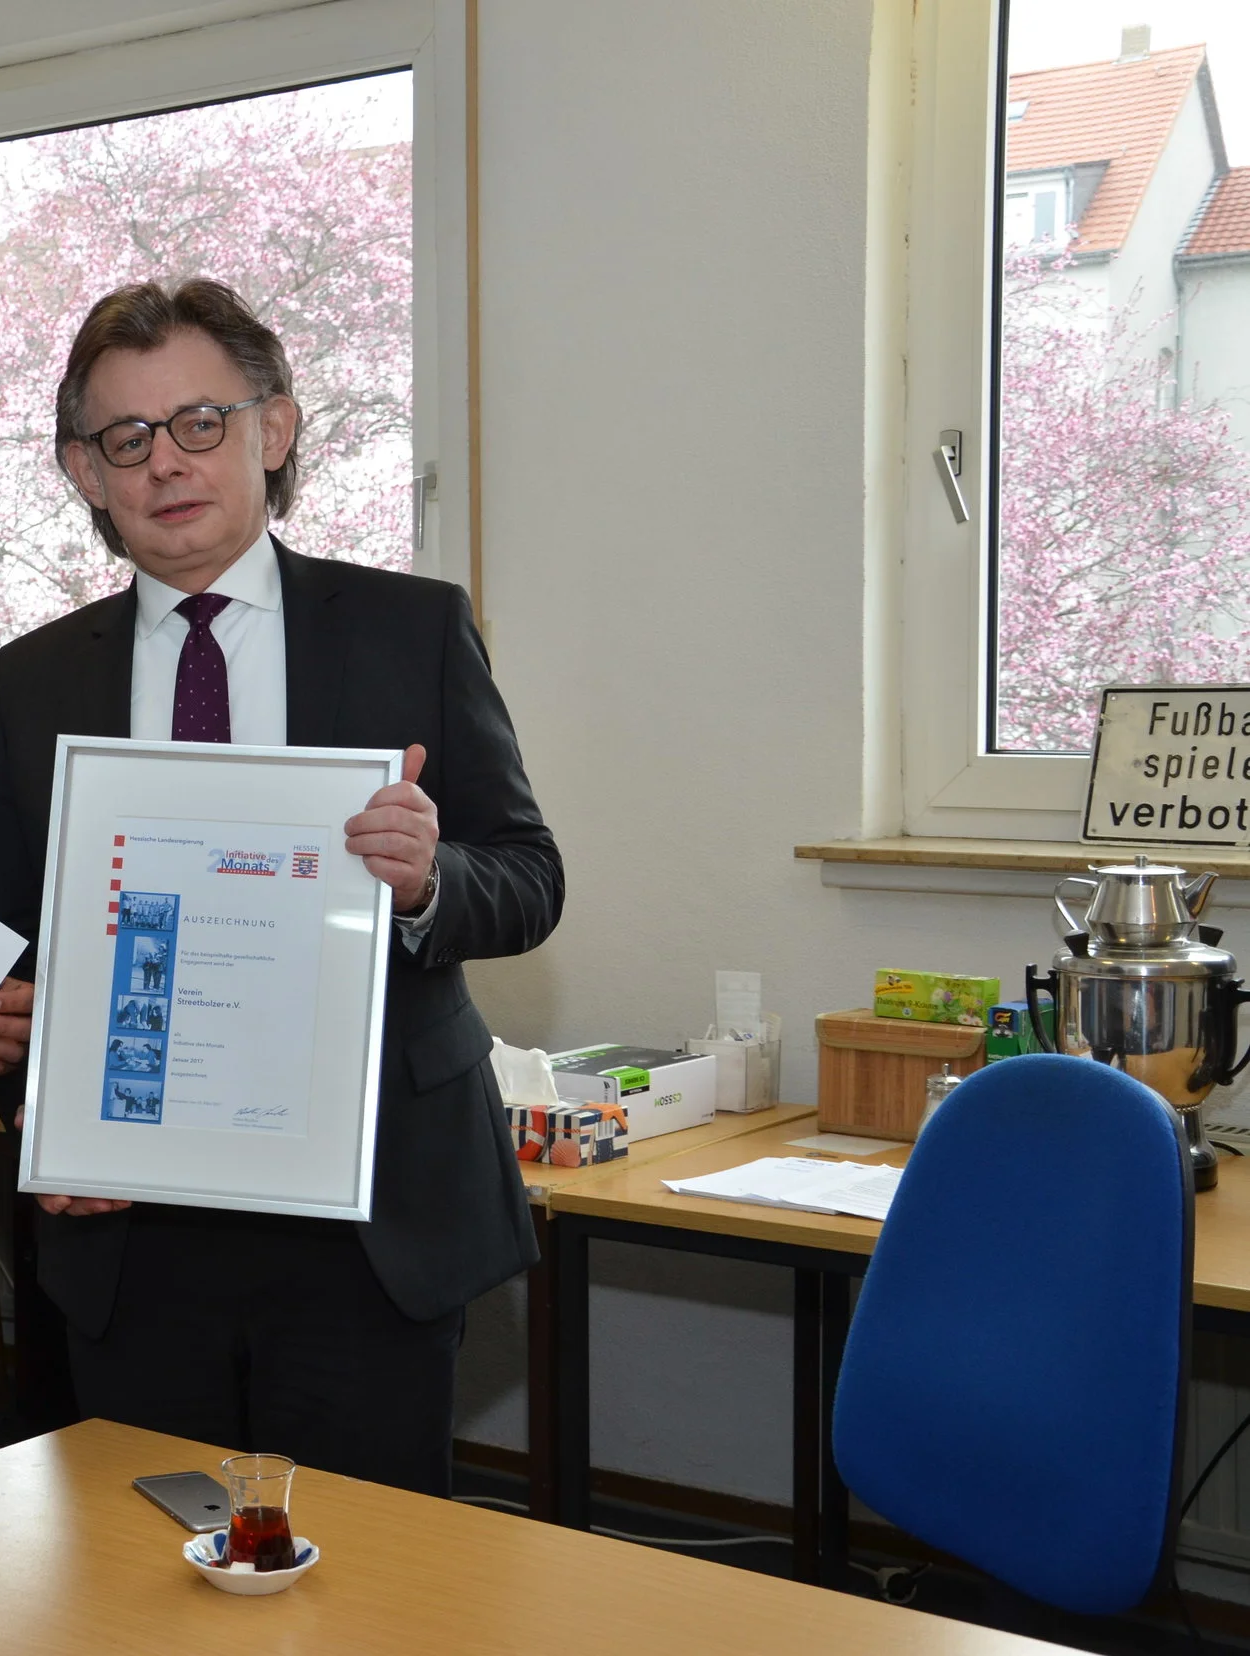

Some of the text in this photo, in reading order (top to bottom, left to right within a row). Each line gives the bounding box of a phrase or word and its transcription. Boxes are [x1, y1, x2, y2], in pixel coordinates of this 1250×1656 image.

[1110, 795, 1248, 831] verbot
[129, 835, 204, 846] Hessische Landesregierung
[293, 844, 320, 852] HESSEN
[225, 850, 267, 860] Initiative
[221, 858, 270, 871] Monats
[183, 915, 276, 928] AUSZEICHNUNG
[178, 987, 203, 996] Verein
[177, 998, 225, 1008] Streetbolzer
